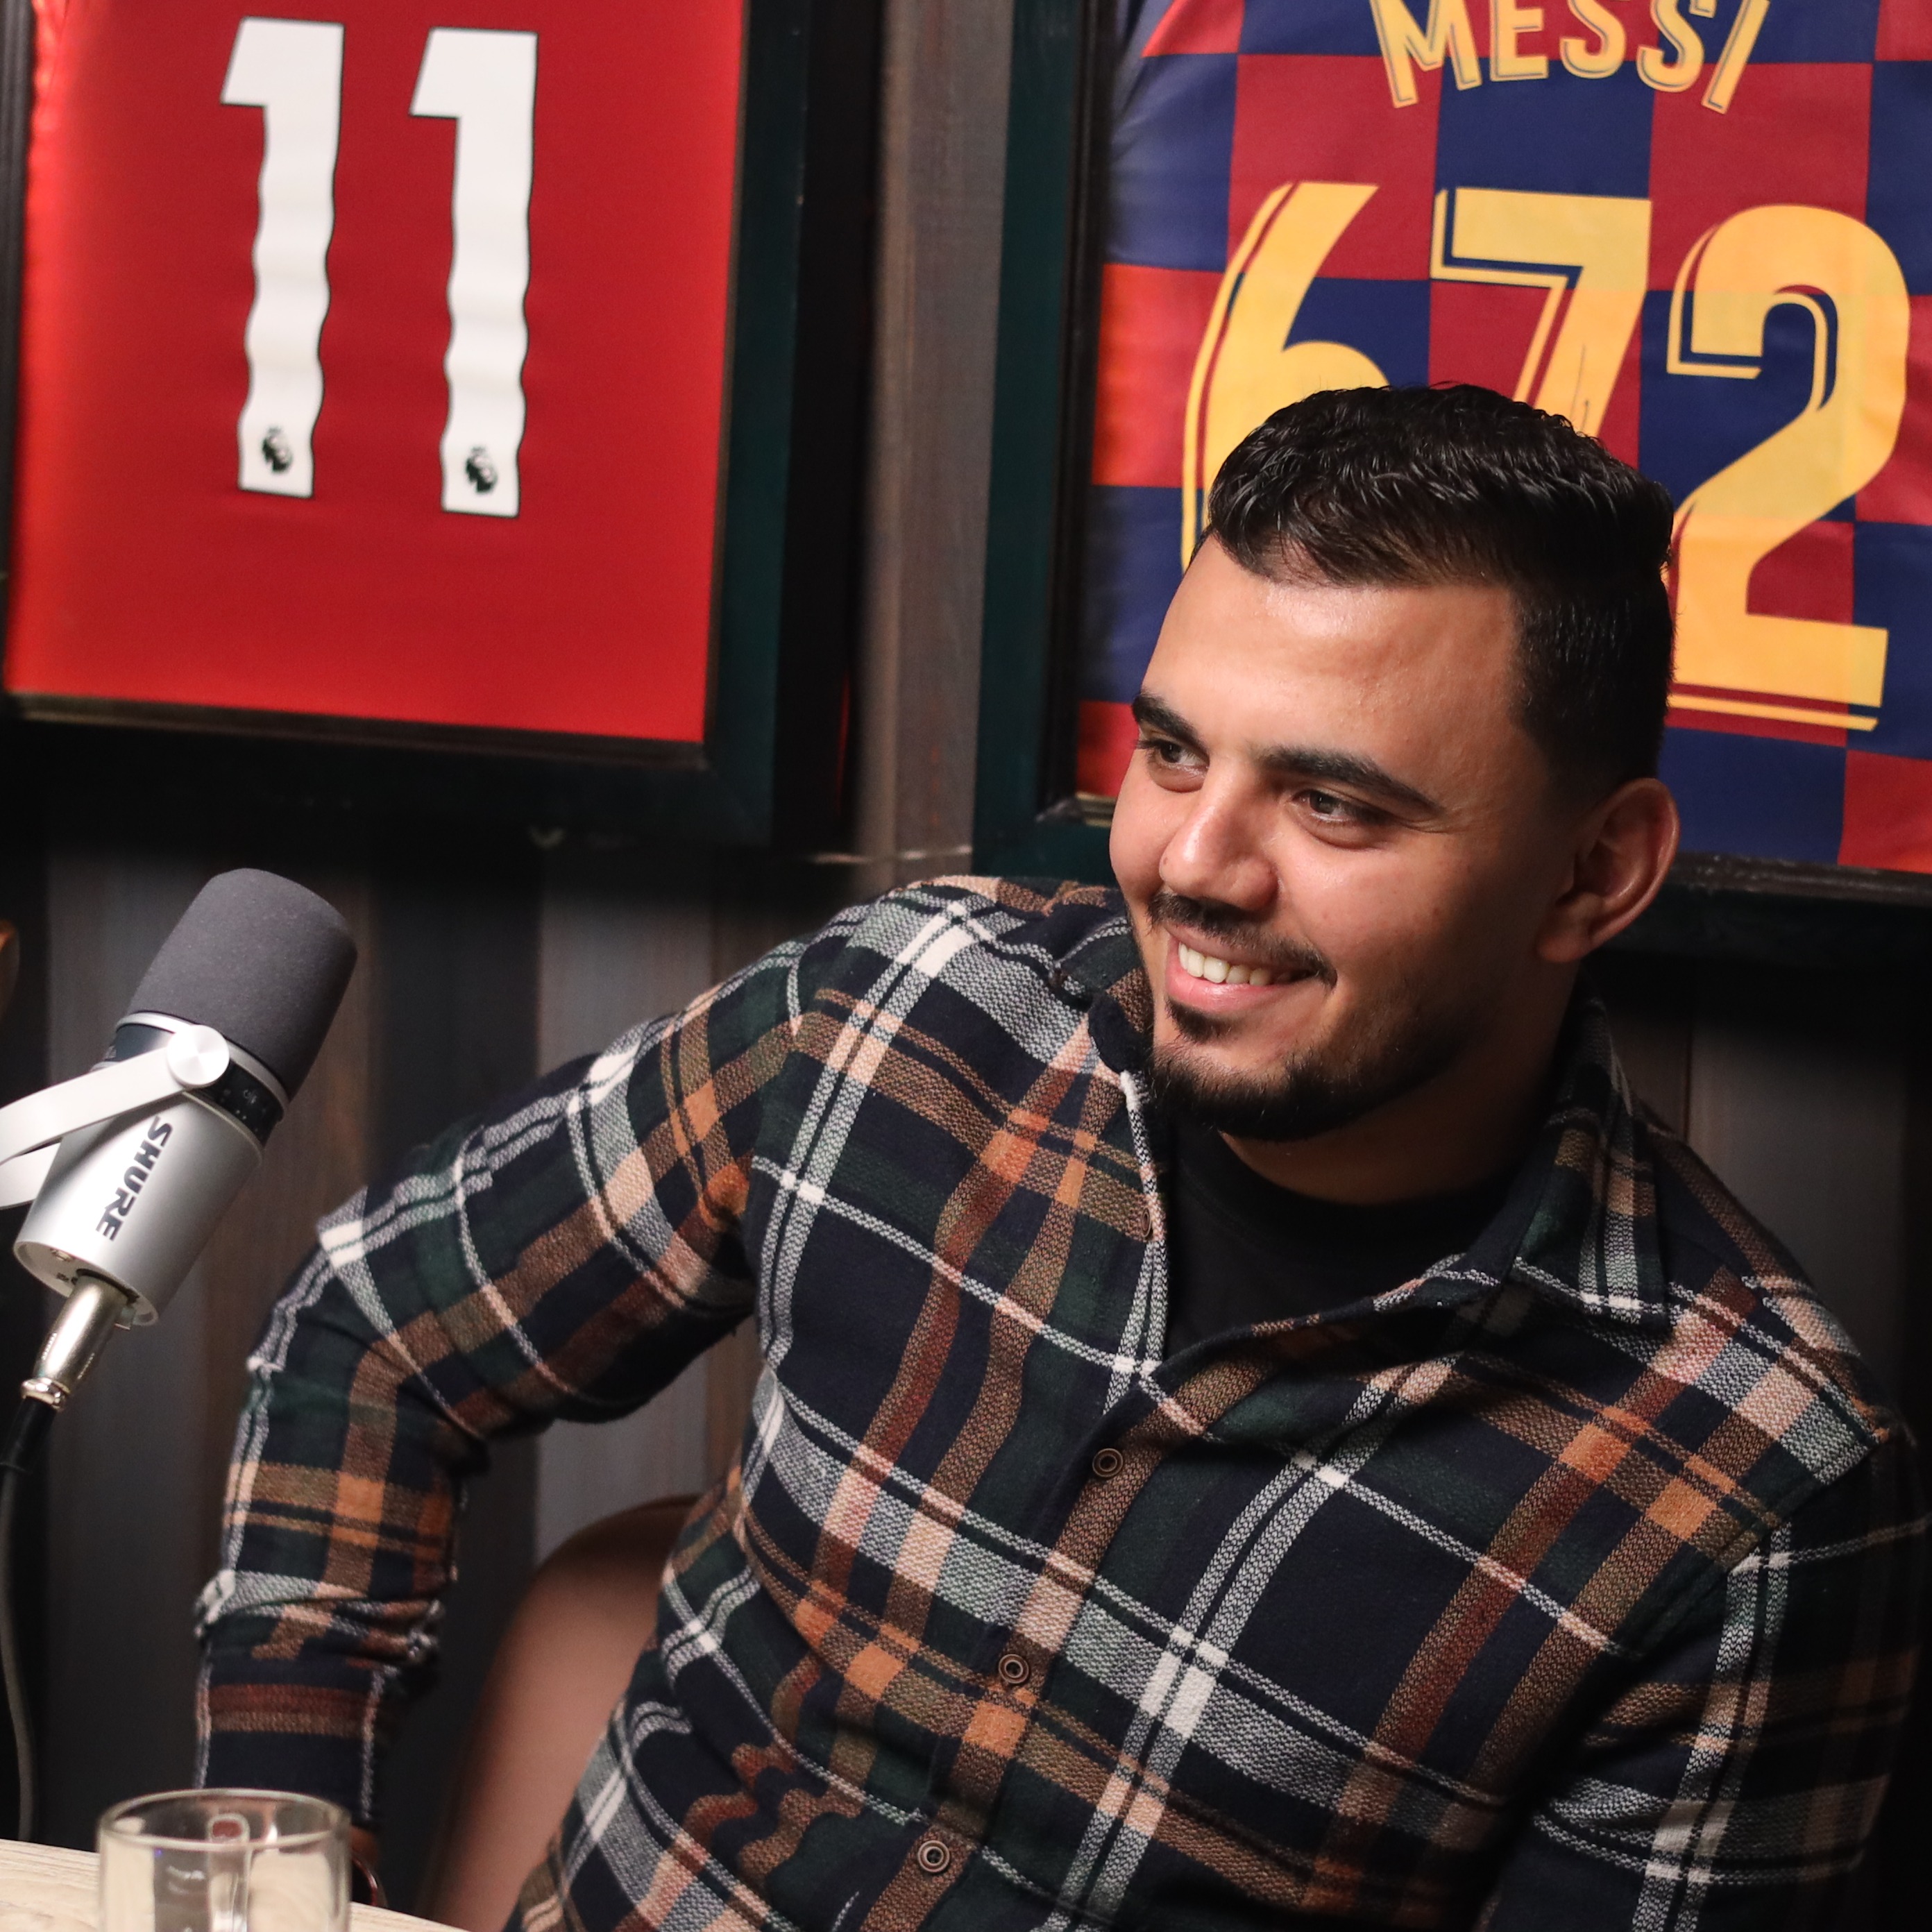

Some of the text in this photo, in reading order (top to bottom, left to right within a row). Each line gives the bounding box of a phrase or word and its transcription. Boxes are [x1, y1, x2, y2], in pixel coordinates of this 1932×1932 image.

[1371, 0, 1770, 114] MESSI
[221, 17, 539, 518] 11
[96, 1115, 173, 1242] SHURE
